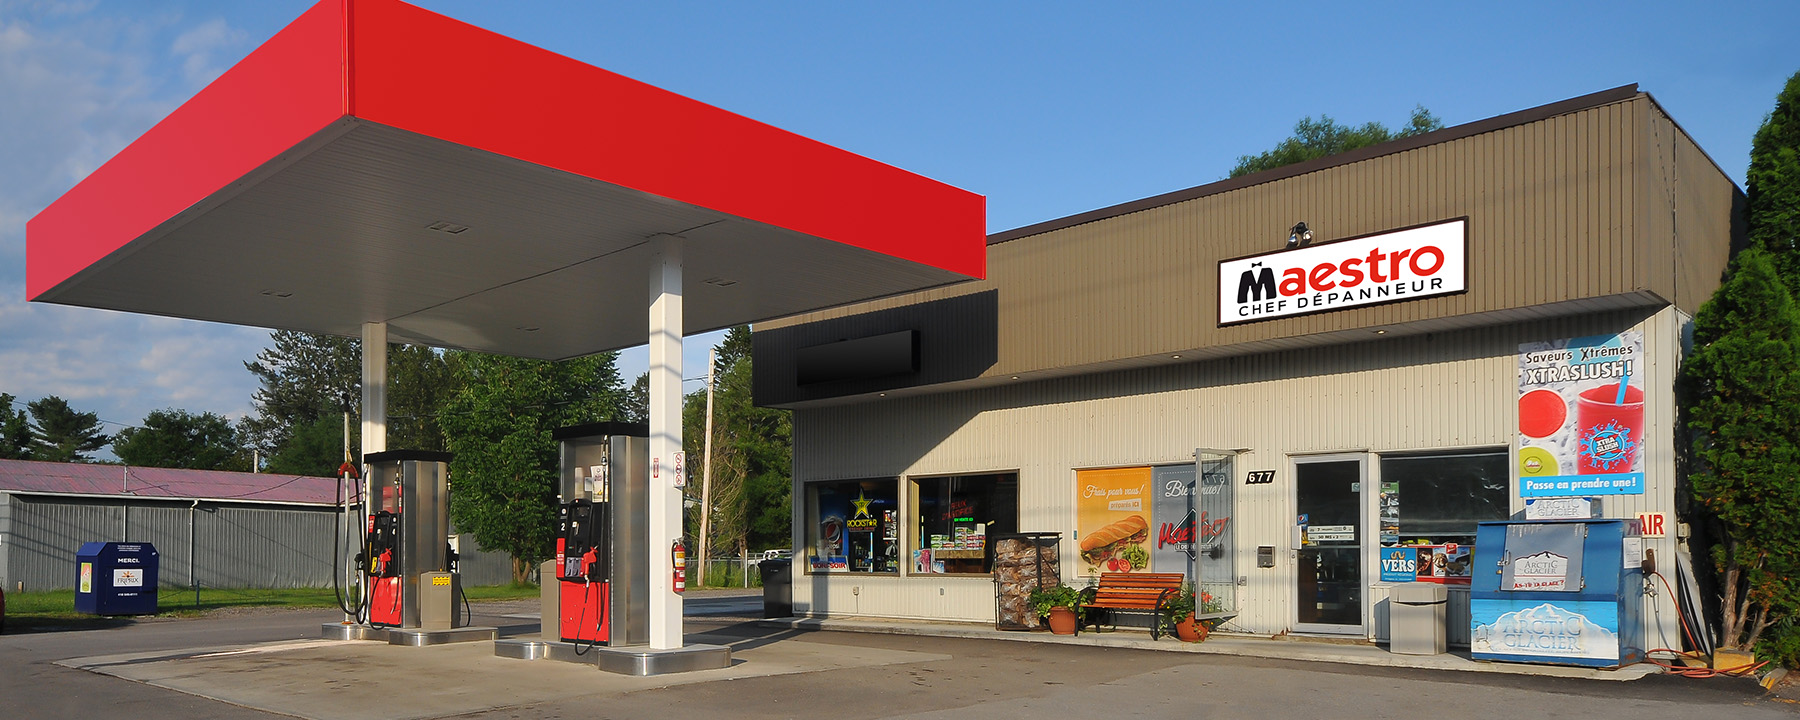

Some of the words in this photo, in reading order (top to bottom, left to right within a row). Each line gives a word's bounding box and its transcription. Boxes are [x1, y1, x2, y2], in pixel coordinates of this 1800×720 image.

[1237, 245, 1445, 303] Maestro
[1238, 300, 1287, 317] CHEF
[1297, 278, 1443, 309] DÉPANNEUR
[1526, 351, 1573, 364] Saveurs
[1580, 345, 1633, 362] Xtrêmes
[1527, 360, 1633, 385] XTRASLUSH!
[1249, 472, 1272, 483] 677
[1526, 480, 1555, 490] Passe
[1556, 481, 1569, 489] en
[1571, 477, 1610, 491] prendre
[1612, 477, 1637, 487] une!
[1083, 484, 1106, 499] Frais
[1537, 499, 1580, 509] ARCTIC
[1537, 508, 1580, 517] GLACIER
[560, 522, 566, 531] 2
[1640, 514, 1664, 535] AIR
[1381, 559, 1415, 572] VERS
[1524, 560, 1559, 569] ARCTIC
[1503, 616, 1581, 636] ARCTIC
[1503, 633, 1581, 651] GLACIER
